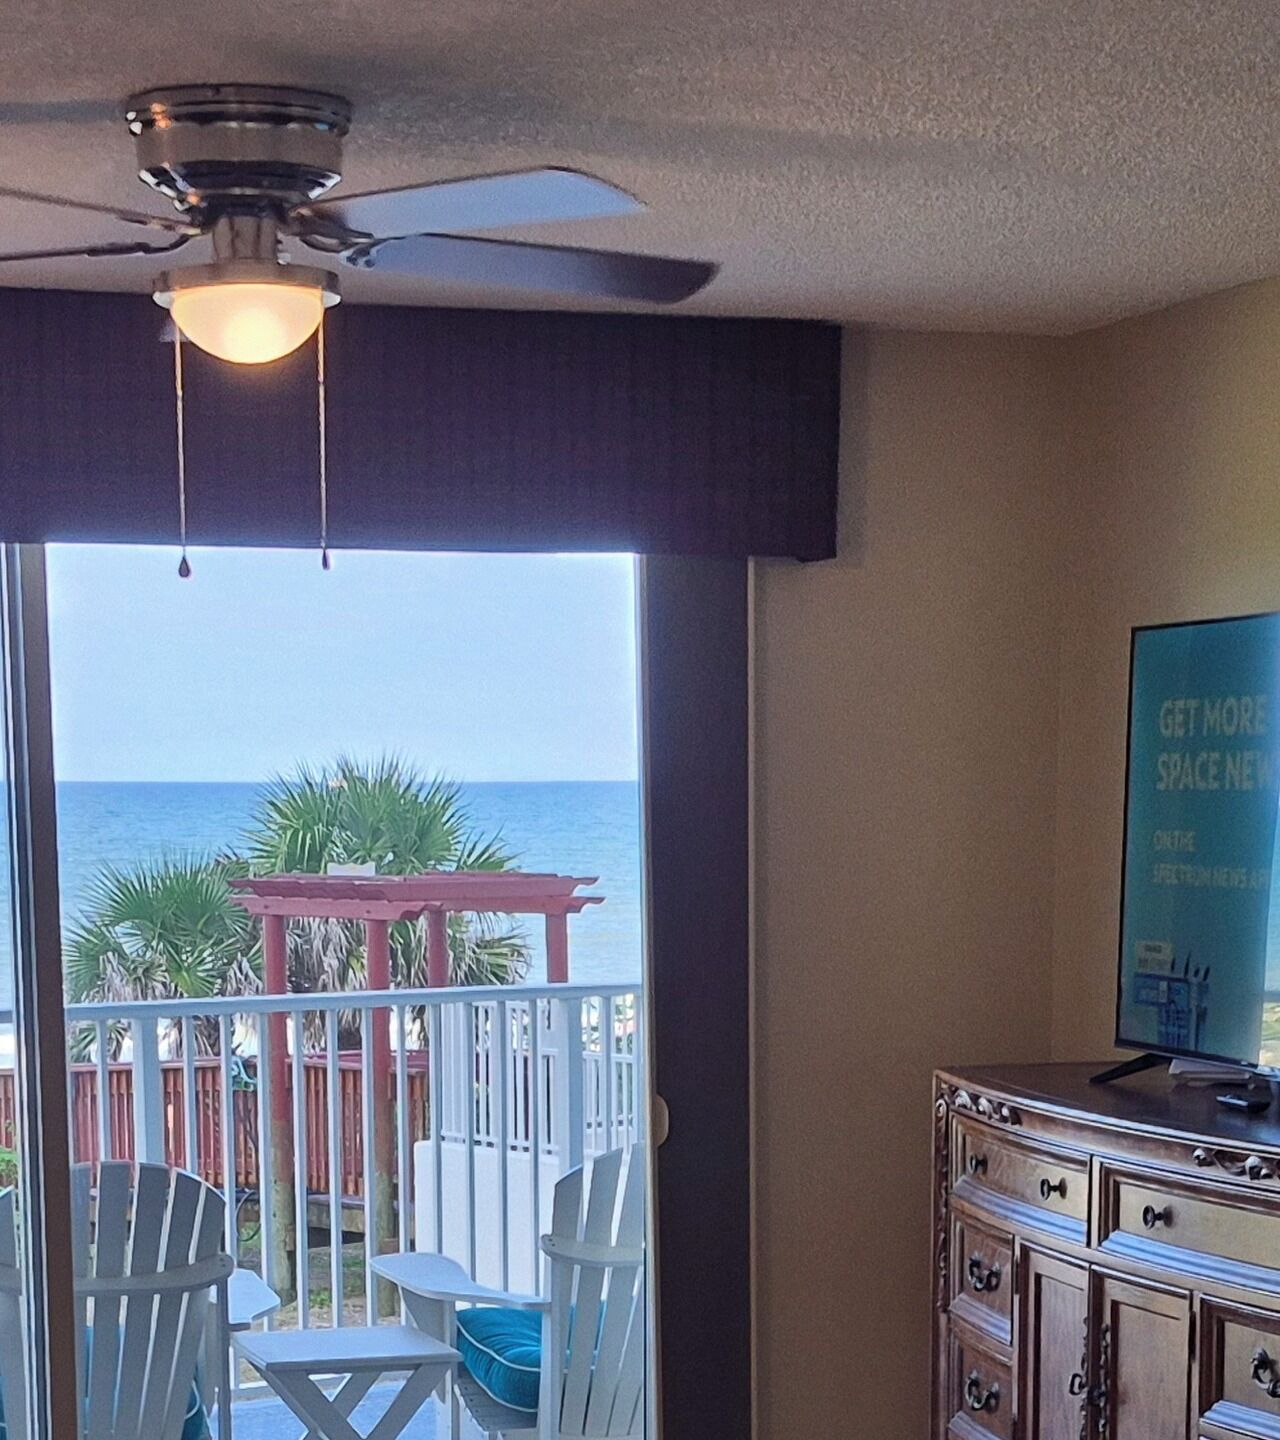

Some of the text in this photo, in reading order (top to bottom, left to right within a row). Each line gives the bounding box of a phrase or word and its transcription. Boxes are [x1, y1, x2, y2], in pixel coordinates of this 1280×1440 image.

[1159, 695, 1268, 738] GET MORE
[1156, 750, 1221, 791] SPACE
